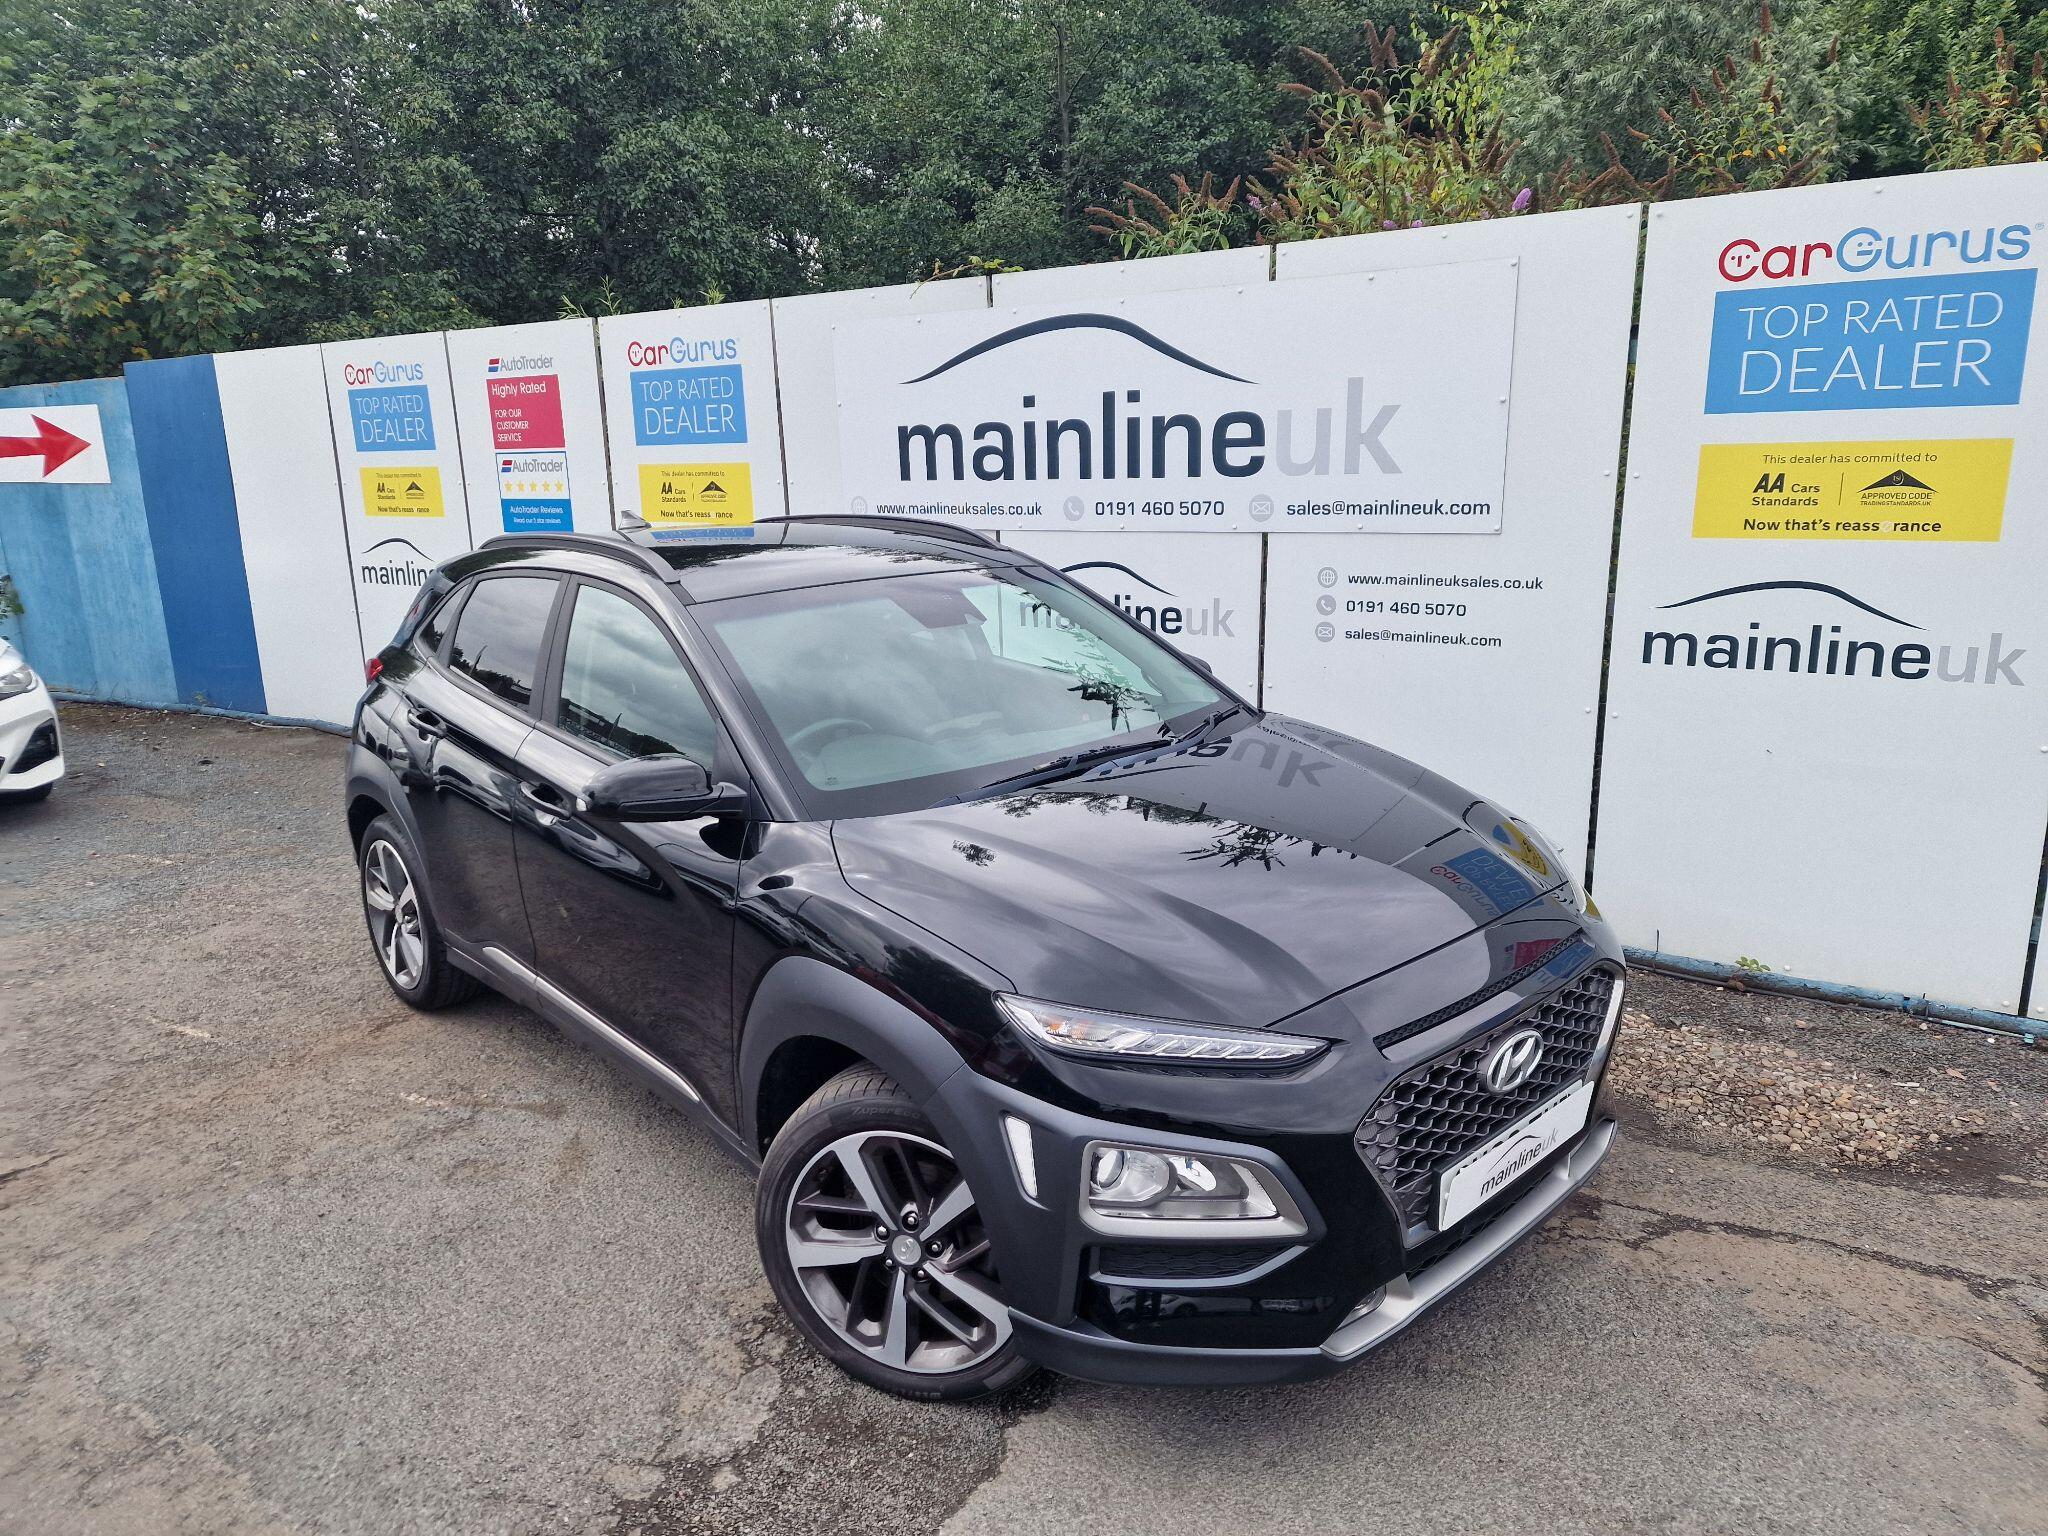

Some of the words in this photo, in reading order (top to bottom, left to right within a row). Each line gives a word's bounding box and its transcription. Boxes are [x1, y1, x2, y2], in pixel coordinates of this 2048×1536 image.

[1717, 224, 2031, 283] CarGurus
[1737, 303, 1829, 340] TOP
[1843, 291, 2004, 335] RATED
[628, 336, 737, 367] CarGurus
[500, 355, 553, 372] AutoTrader
[1737, 338, 1994, 396] DEALER
[344, 361, 424, 385] CarGurus
[491, 383, 518, 398] Highly
[520, 381, 547, 394] Rated
[640, 380, 673, 402] TOP
[678, 377, 734, 400] RATED
[355, 397, 380, 415] TOP
[382, 394, 424, 414] RATED
[495, 409, 508, 418] FOR
[508, 408, 522, 418] OUR
[496, 420, 529, 430] CUSTOMER
[644, 404, 736, 435] DEALER
[360, 417, 428, 443] DEALER
[497, 432, 522, 442] SERVICE
[512, 459, 564, 473] AutoTrader
[1762, 454, 1787, 465] This
[1789, 454, 1828, 464] dealer
[1829, 453, 1851, 464] has
[1853, 452, 1921, 463] committed
[1924, 452, 1938, 462] to
[661, 482, 672, 494] AA
[1752, 472, 1786, 494] AA
[1791, 483, 1821, 494] Cars
[1751, 496, 1819, 507] Standards
[1860, 491, 1908, 500] APPROVED
[1908, 491, 1933, 500] CODE
[876, 501, 1042, 516] www.mainlineuksales.co.uk
[1094, 500, 1136, 517] 0191
[1141, 500, 1174, 516] 460
[1179, 500, 1225, 516] 5070
[1286, 498, 1492, 517] sales@mainlineuk.com
[1743, 518, 1780, 531] Now
[1347, 574, 1544, 590] www.mainlineuksales.co.uk
[1346, 600, 1384, 613] 0191
[1389, 601, 1420, 615] 460
[1424, 603, 1467, 617] 5070
[1345, 628, 1502, 647] sales@mainlineuk.com
